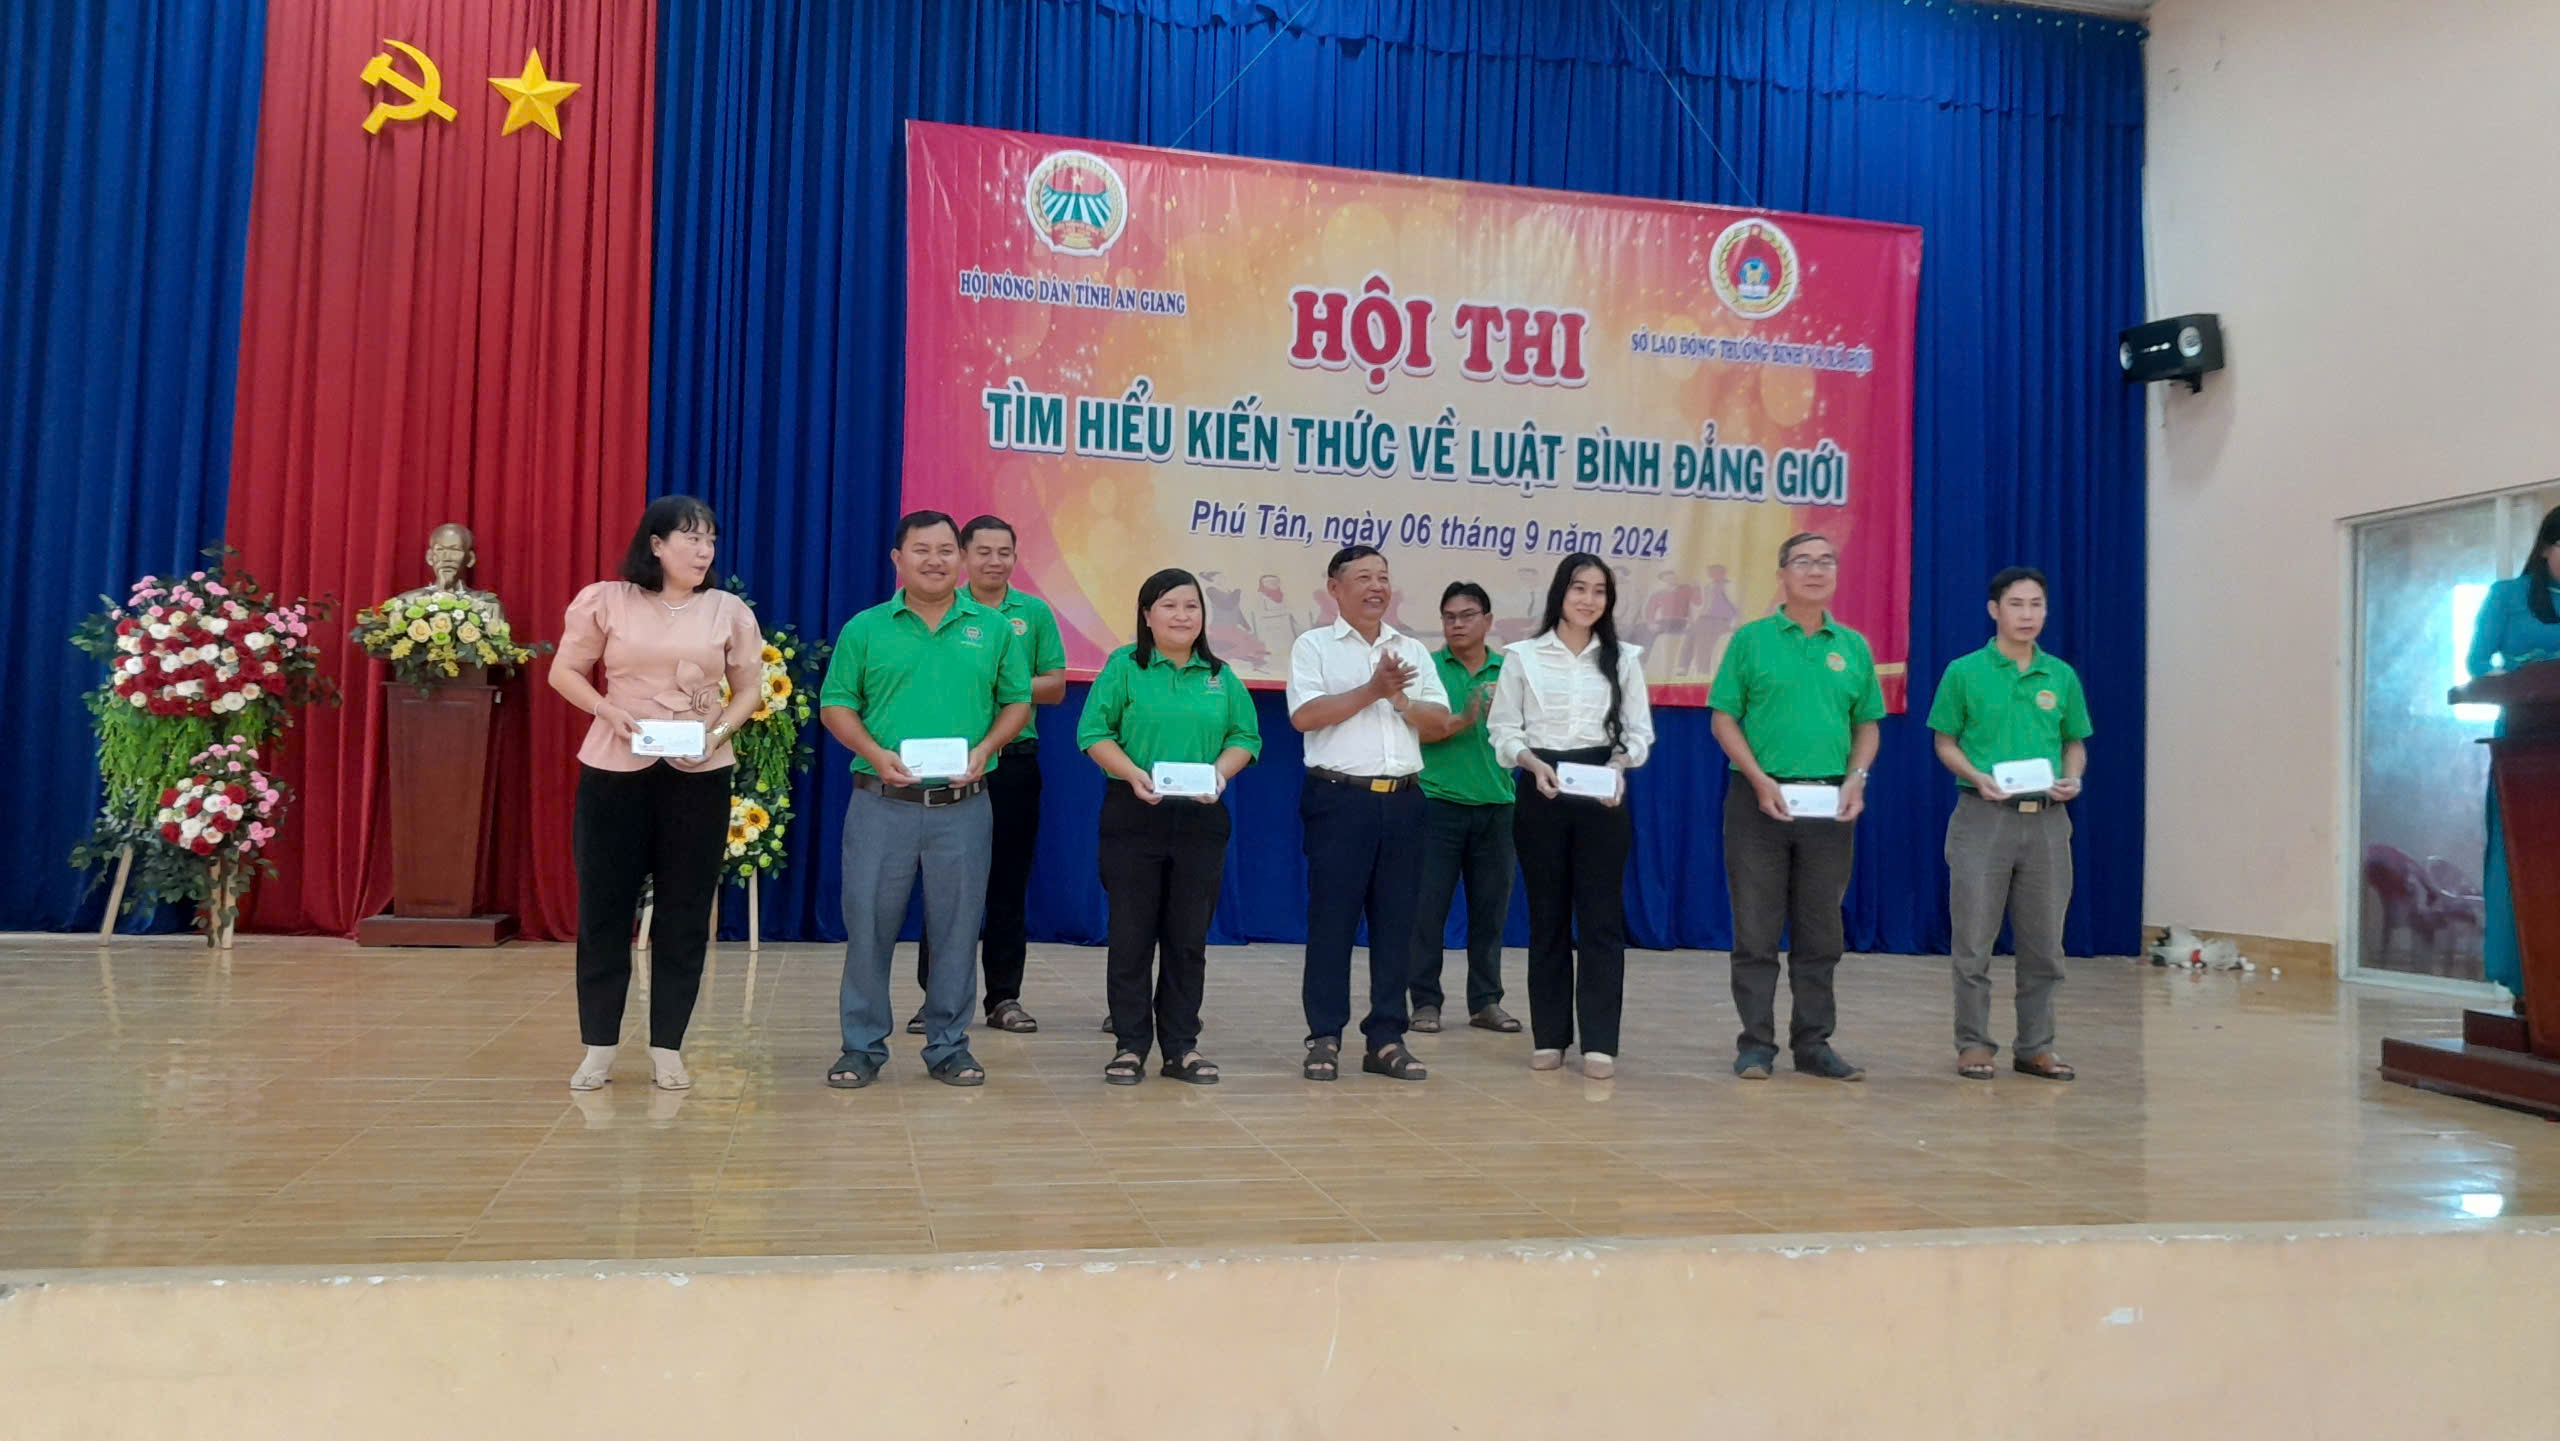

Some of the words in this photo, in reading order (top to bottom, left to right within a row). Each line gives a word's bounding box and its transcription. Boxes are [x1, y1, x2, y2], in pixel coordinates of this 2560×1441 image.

[960, 266, 987, 301] HỘI
[991, 269, 1034, 300] NÔNG
[1039, 275, 1071, 303] DÂN
[1075, 277, 1111, 308] TỈNH
[1115, 288, 1137, 310] AN
[1140, 289, 1186, 314] GIANG
[1290, 274, 1434, 386] HỘI
[1455, 302, 1587, 380] THI
[1651, 334, 1675, 355] LAO
[987, 381, 1063, 447] TÌM
[1079, 379, 1173, 456] HIỂU
[1188, 395, 1279, 464] KIẾN
[1290, 409, 1396, 471] THỨC
[1408, 407, 1457, 474] VỀ
[1471, 421, 1564, 491] LUẬT
[1577, 425, 1661, 488] BÌNH
[1776, 443, 1844, 499] GIỚI
[1191, 500, 1246, 535] Phú
[1257, 504, 1313, 544] Tân,
[1324, 510, 1392, 549] ngày
[1400, 513, 1432, 545] 06
[1441, 516, 1516, 557] tháng
[1525, 519, 1539, 550] 9
[1547, 523, 1601, 554] năm
[1611, 526, 1669, 557] 2024
